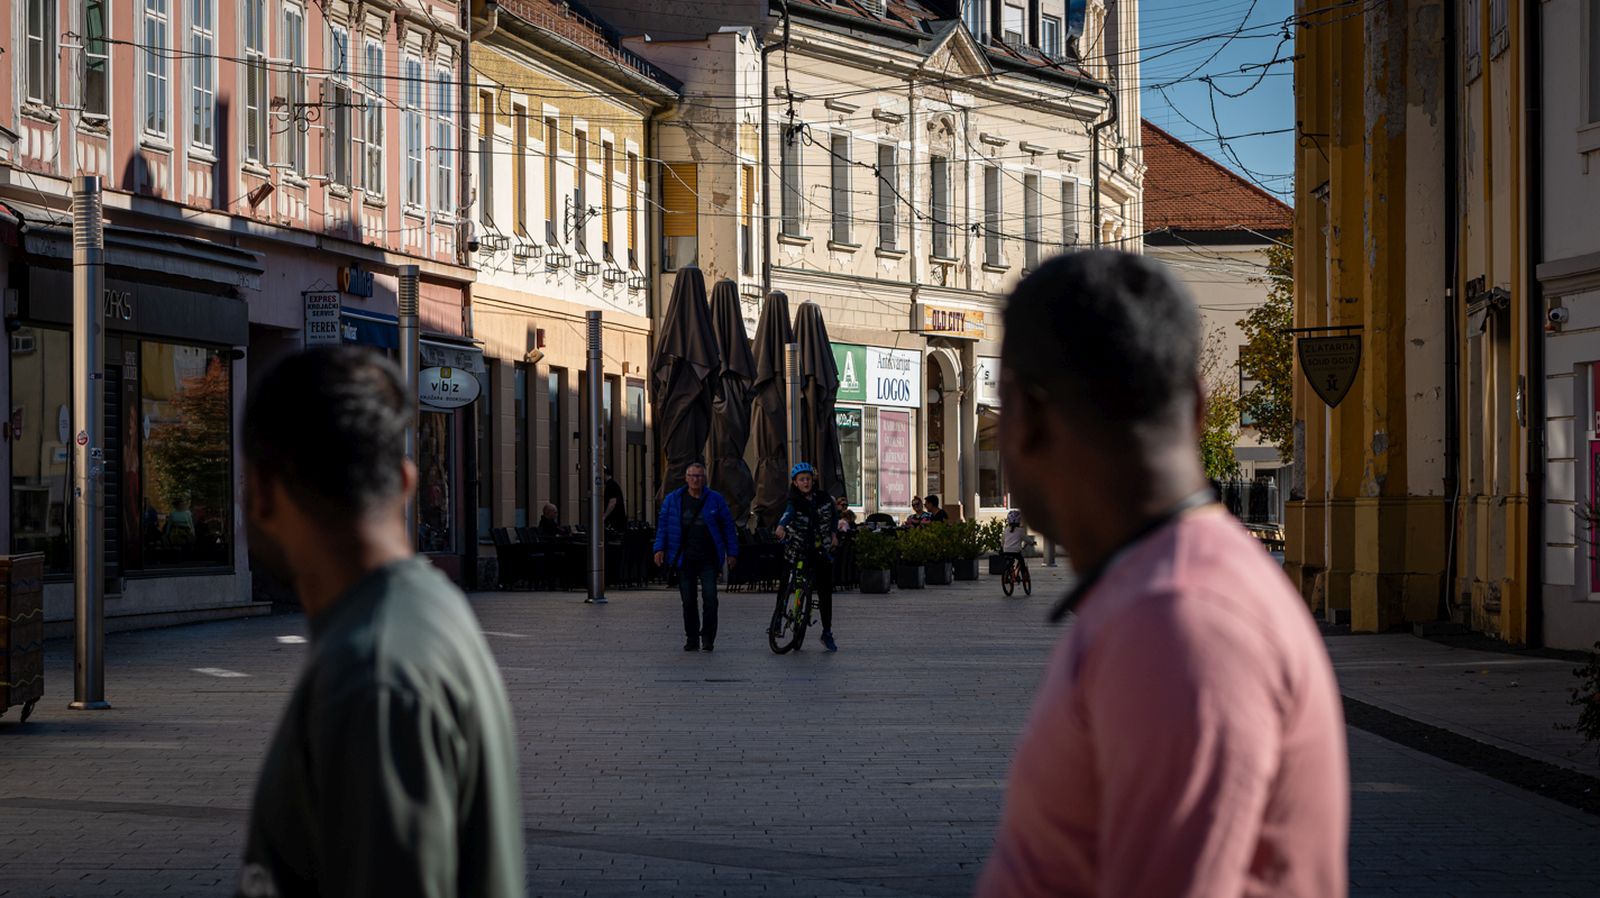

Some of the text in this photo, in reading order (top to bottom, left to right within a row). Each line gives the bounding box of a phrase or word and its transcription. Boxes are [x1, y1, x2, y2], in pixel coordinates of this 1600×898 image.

[309, 295, 337, 303] EXPRES
[932, 310, 966, 332] OLD CITY
[877, 377, 911, 402] LOGOS
